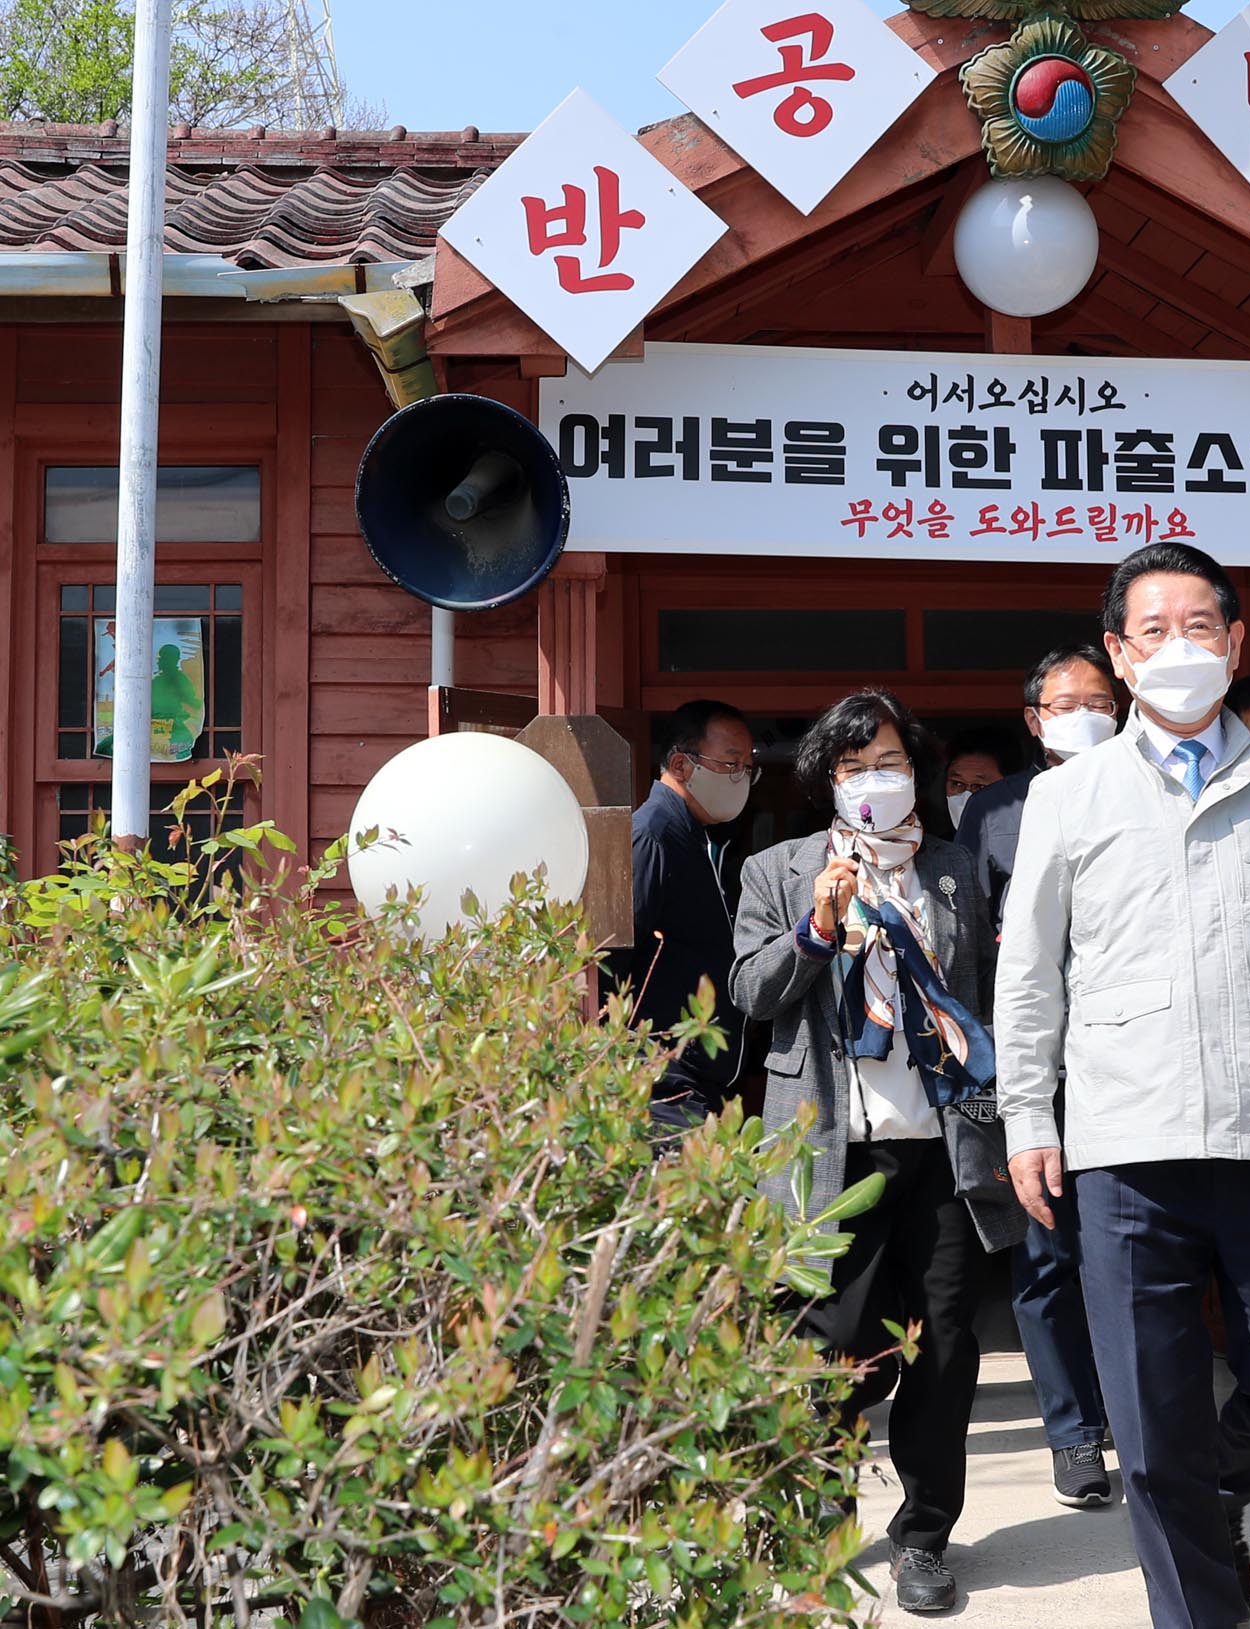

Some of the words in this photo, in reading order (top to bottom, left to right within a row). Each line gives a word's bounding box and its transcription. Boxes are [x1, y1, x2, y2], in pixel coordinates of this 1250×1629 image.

[733, 12, 855, 137] 공
[521, 166, 646, 294] 반
[906, 372, 1127, 417] 어서오십시오
[558, 413, 847, 486] 여러분을
[876, 424, 1017, 490] 위한
[840, 498, 955, 540] 무엇을
[969, 501, 1196, 543] 도와드릴까요
